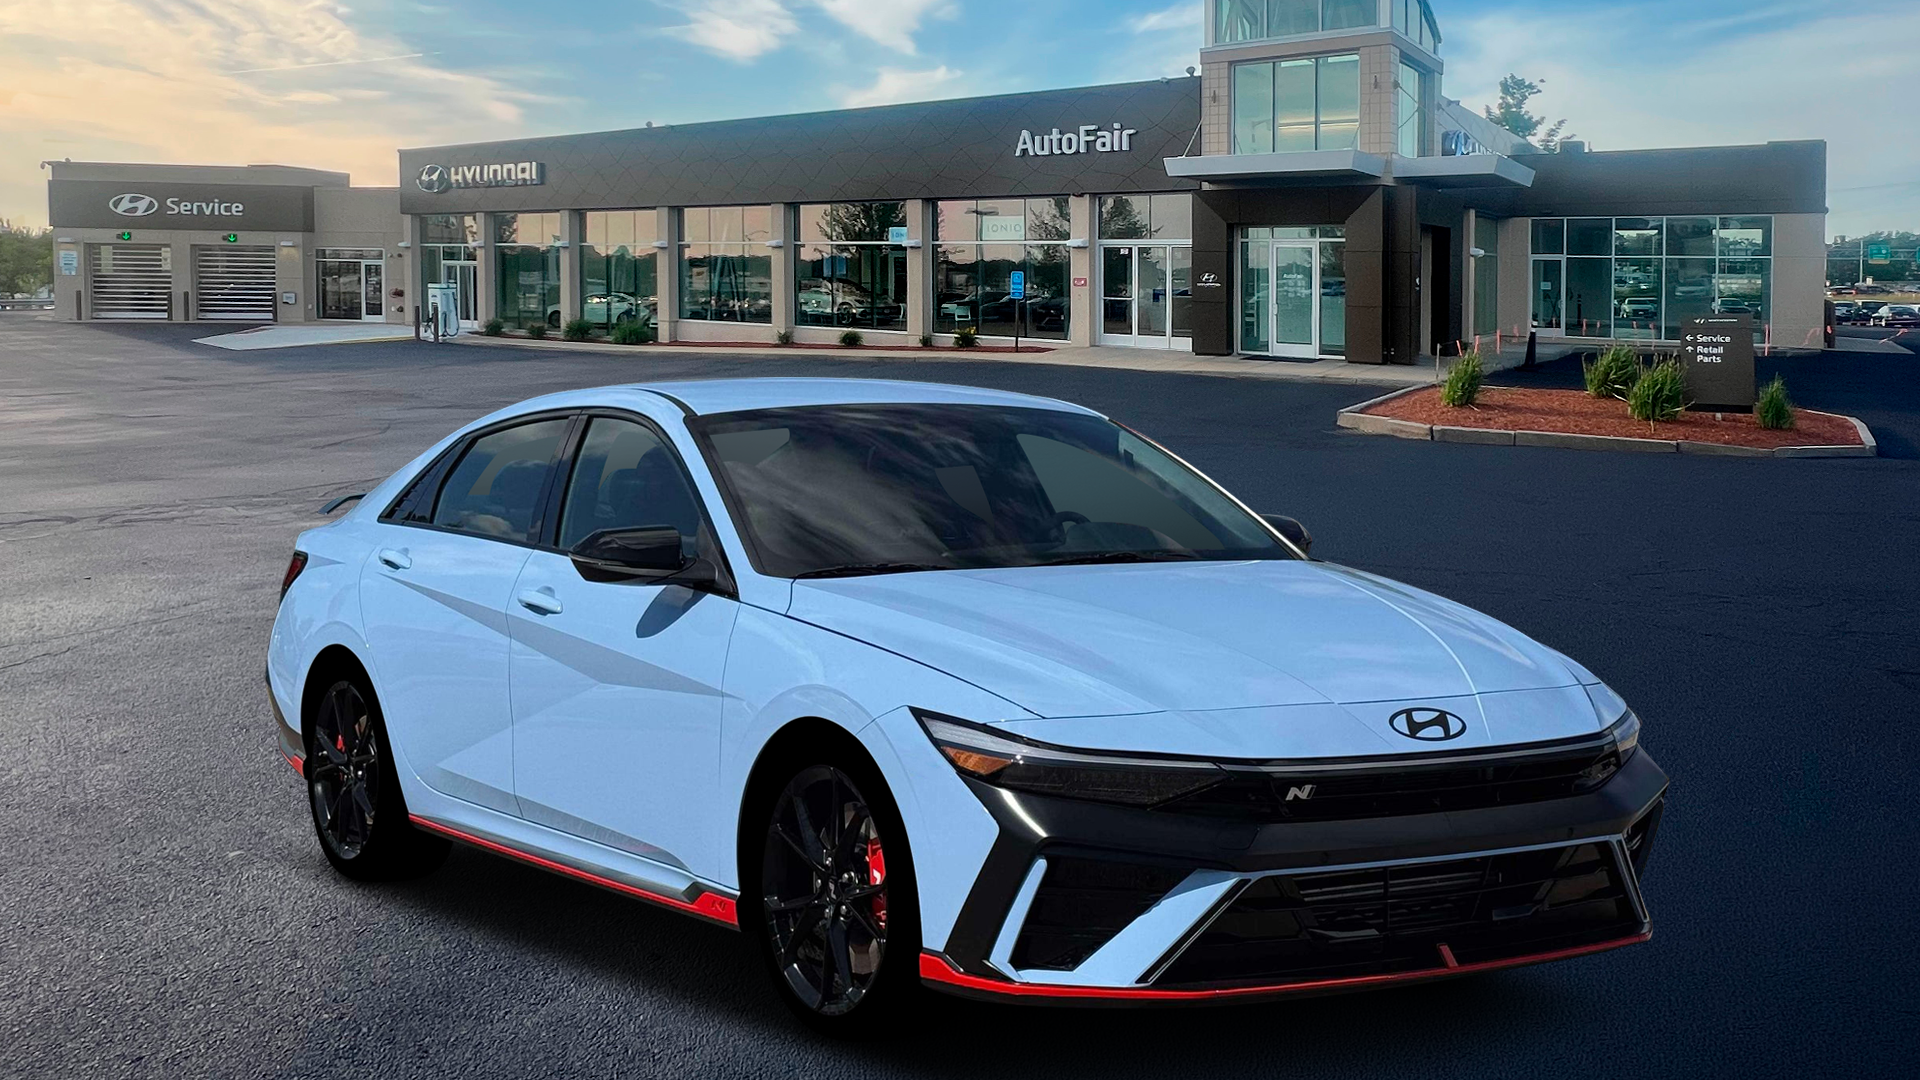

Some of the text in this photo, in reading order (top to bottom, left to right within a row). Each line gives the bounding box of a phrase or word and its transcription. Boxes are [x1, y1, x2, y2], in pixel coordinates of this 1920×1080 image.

[1015, 122, 1137, 157] AutoFair
[450, 161, 540, 187] HYUNDAI
[166, 197, 244, 216] Service
[986, 223, 1022, 233] IONIQ
[1696, 334, 1731, 343] Service
[1696, 345, 1724, 354] Retail
[1696, 355, 1722, 363] Parts
